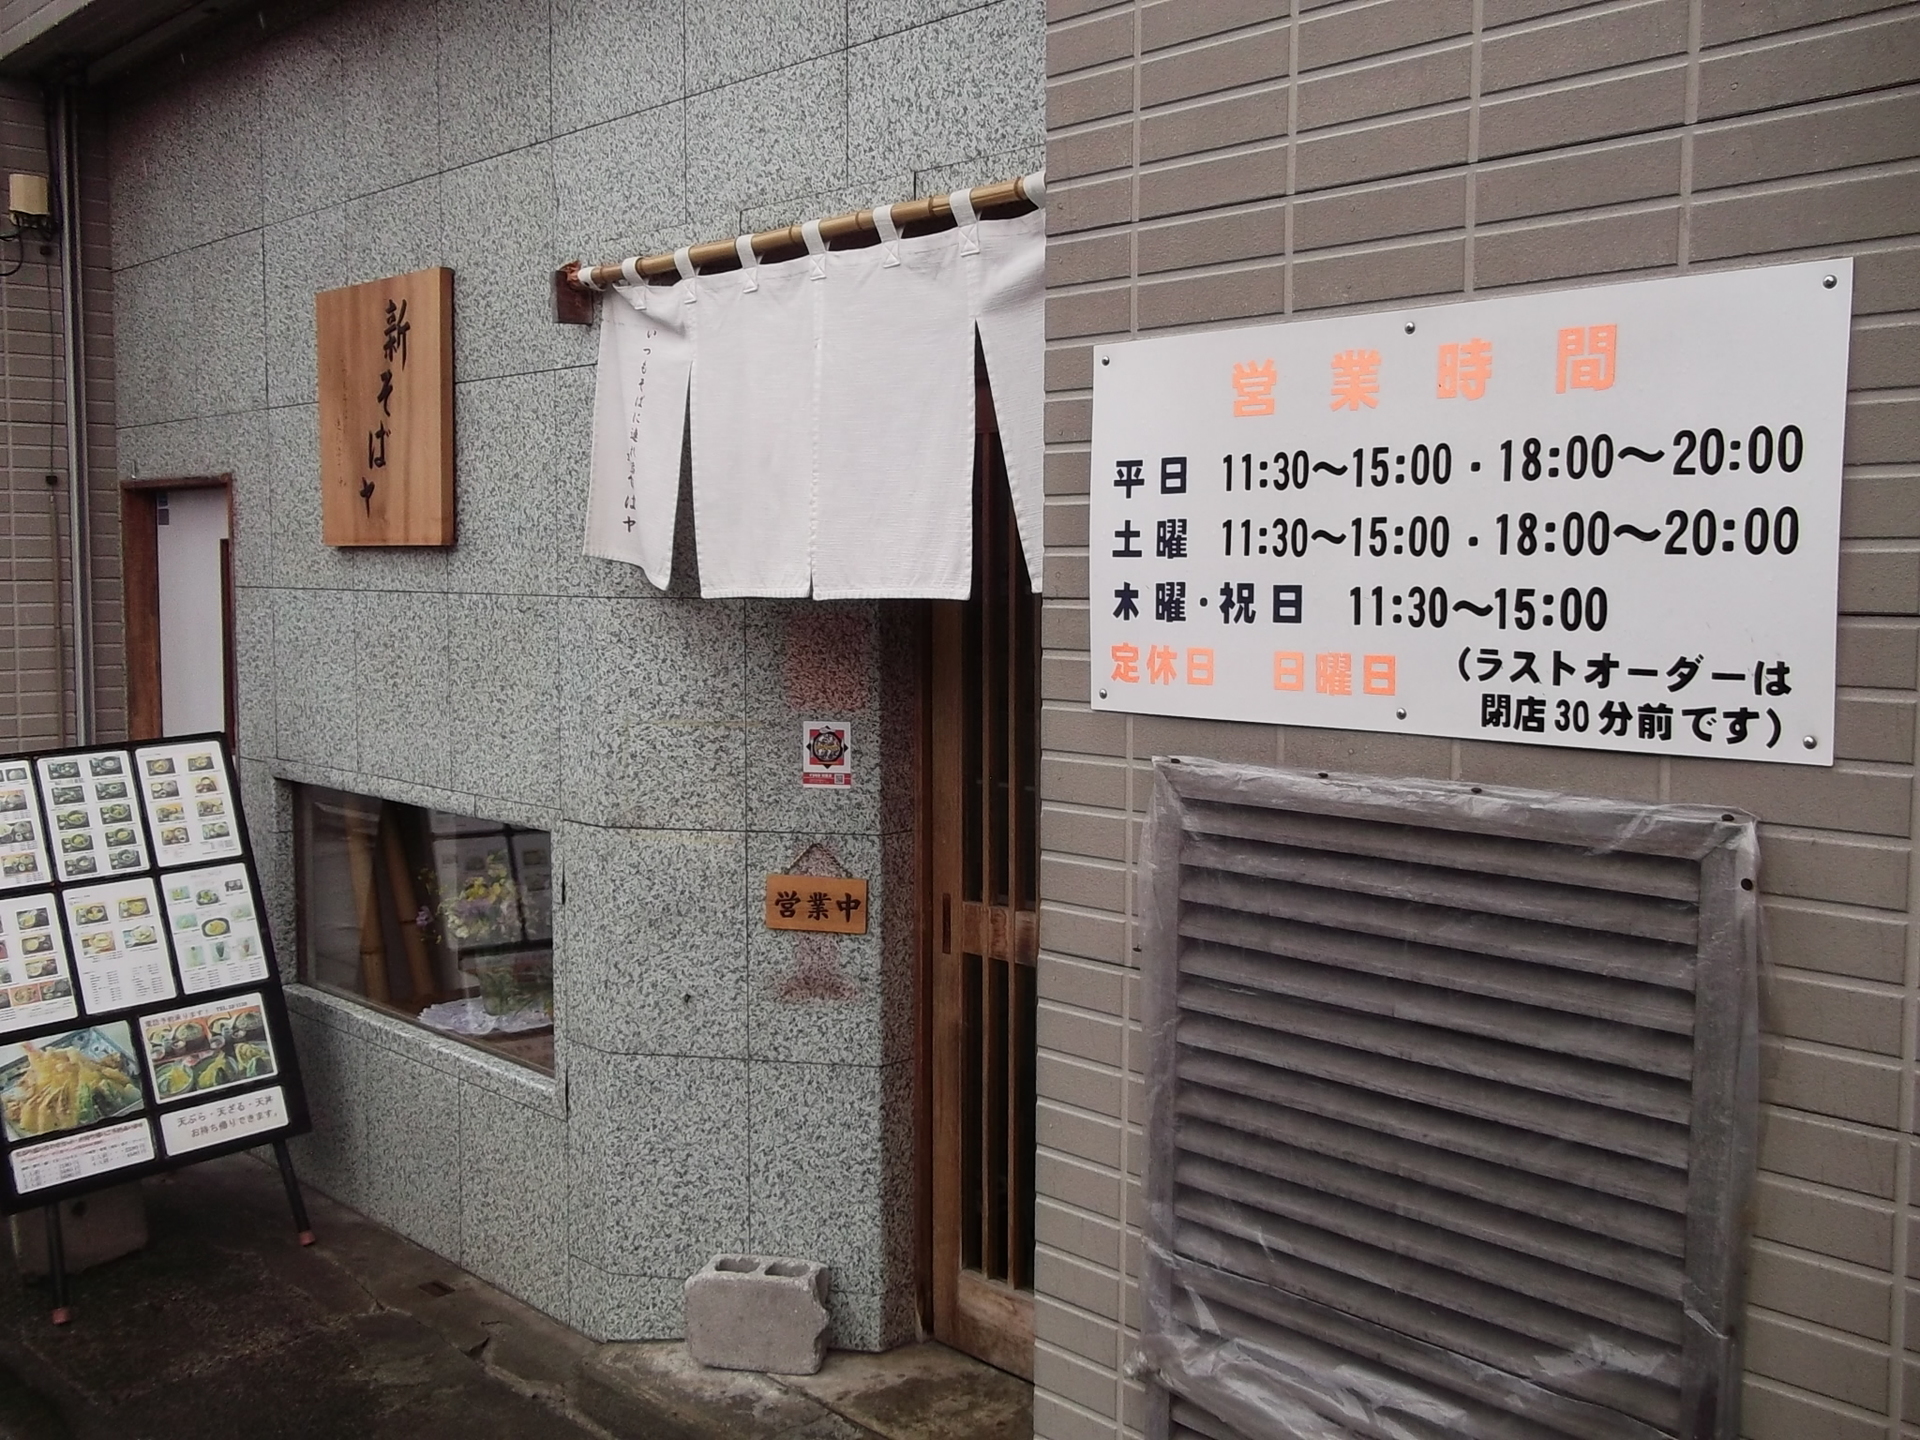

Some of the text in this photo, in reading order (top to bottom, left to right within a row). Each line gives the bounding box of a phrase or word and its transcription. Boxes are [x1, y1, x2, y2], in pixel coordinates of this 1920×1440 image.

[1232, 324, 1617, 417] 営業時間
[1113, 456, 1188, 499] 平日
[1112, 518, 1188, 560] 土曜
[1110, 642, 1397, 697] 定休日 日曜日
[774, 890, 861, 922] 営業中
